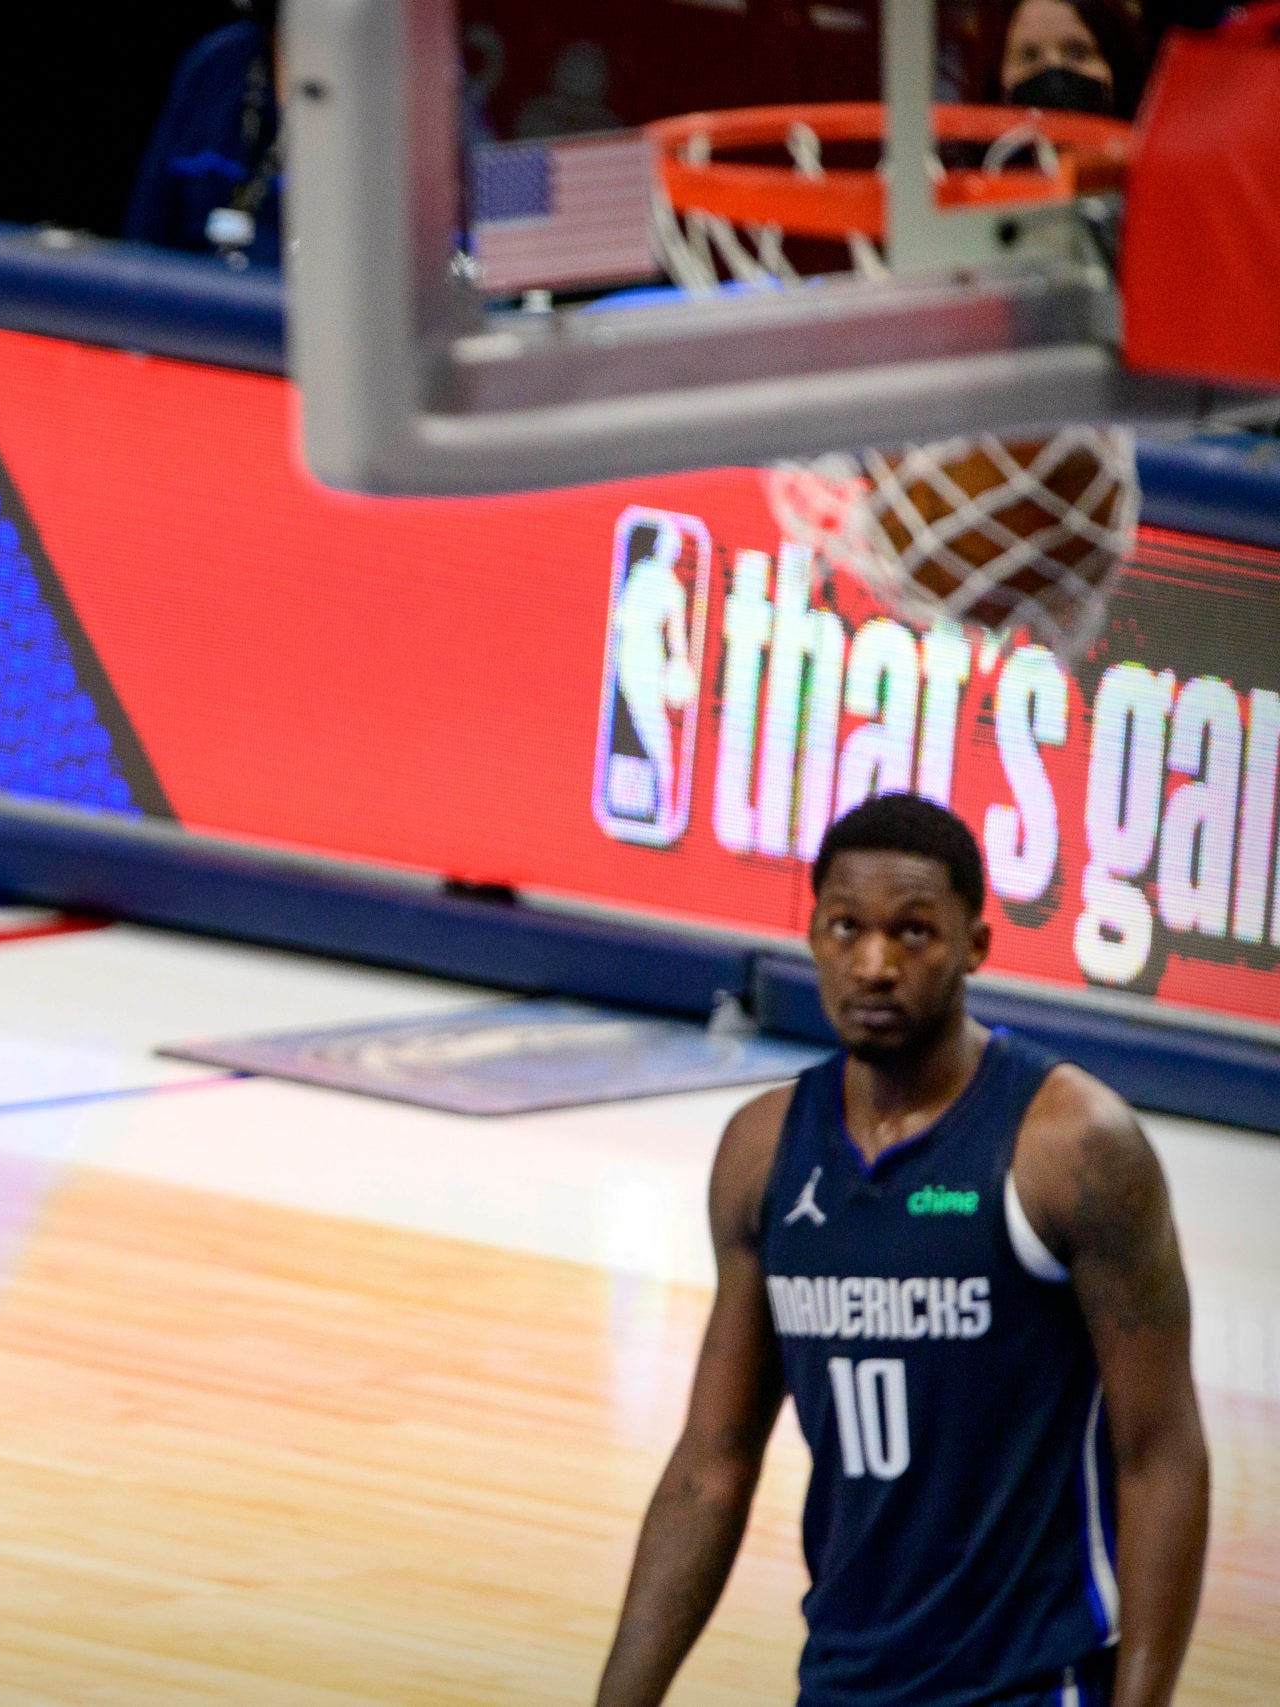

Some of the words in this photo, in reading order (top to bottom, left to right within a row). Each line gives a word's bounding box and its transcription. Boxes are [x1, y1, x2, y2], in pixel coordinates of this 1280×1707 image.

[711, 537, 1069, 899] that's
[906, 1185, 980, 1217] chime
[766, 1275, 992, 1340] MAVERICKS
[827, 1356, 912, 1481] 10
